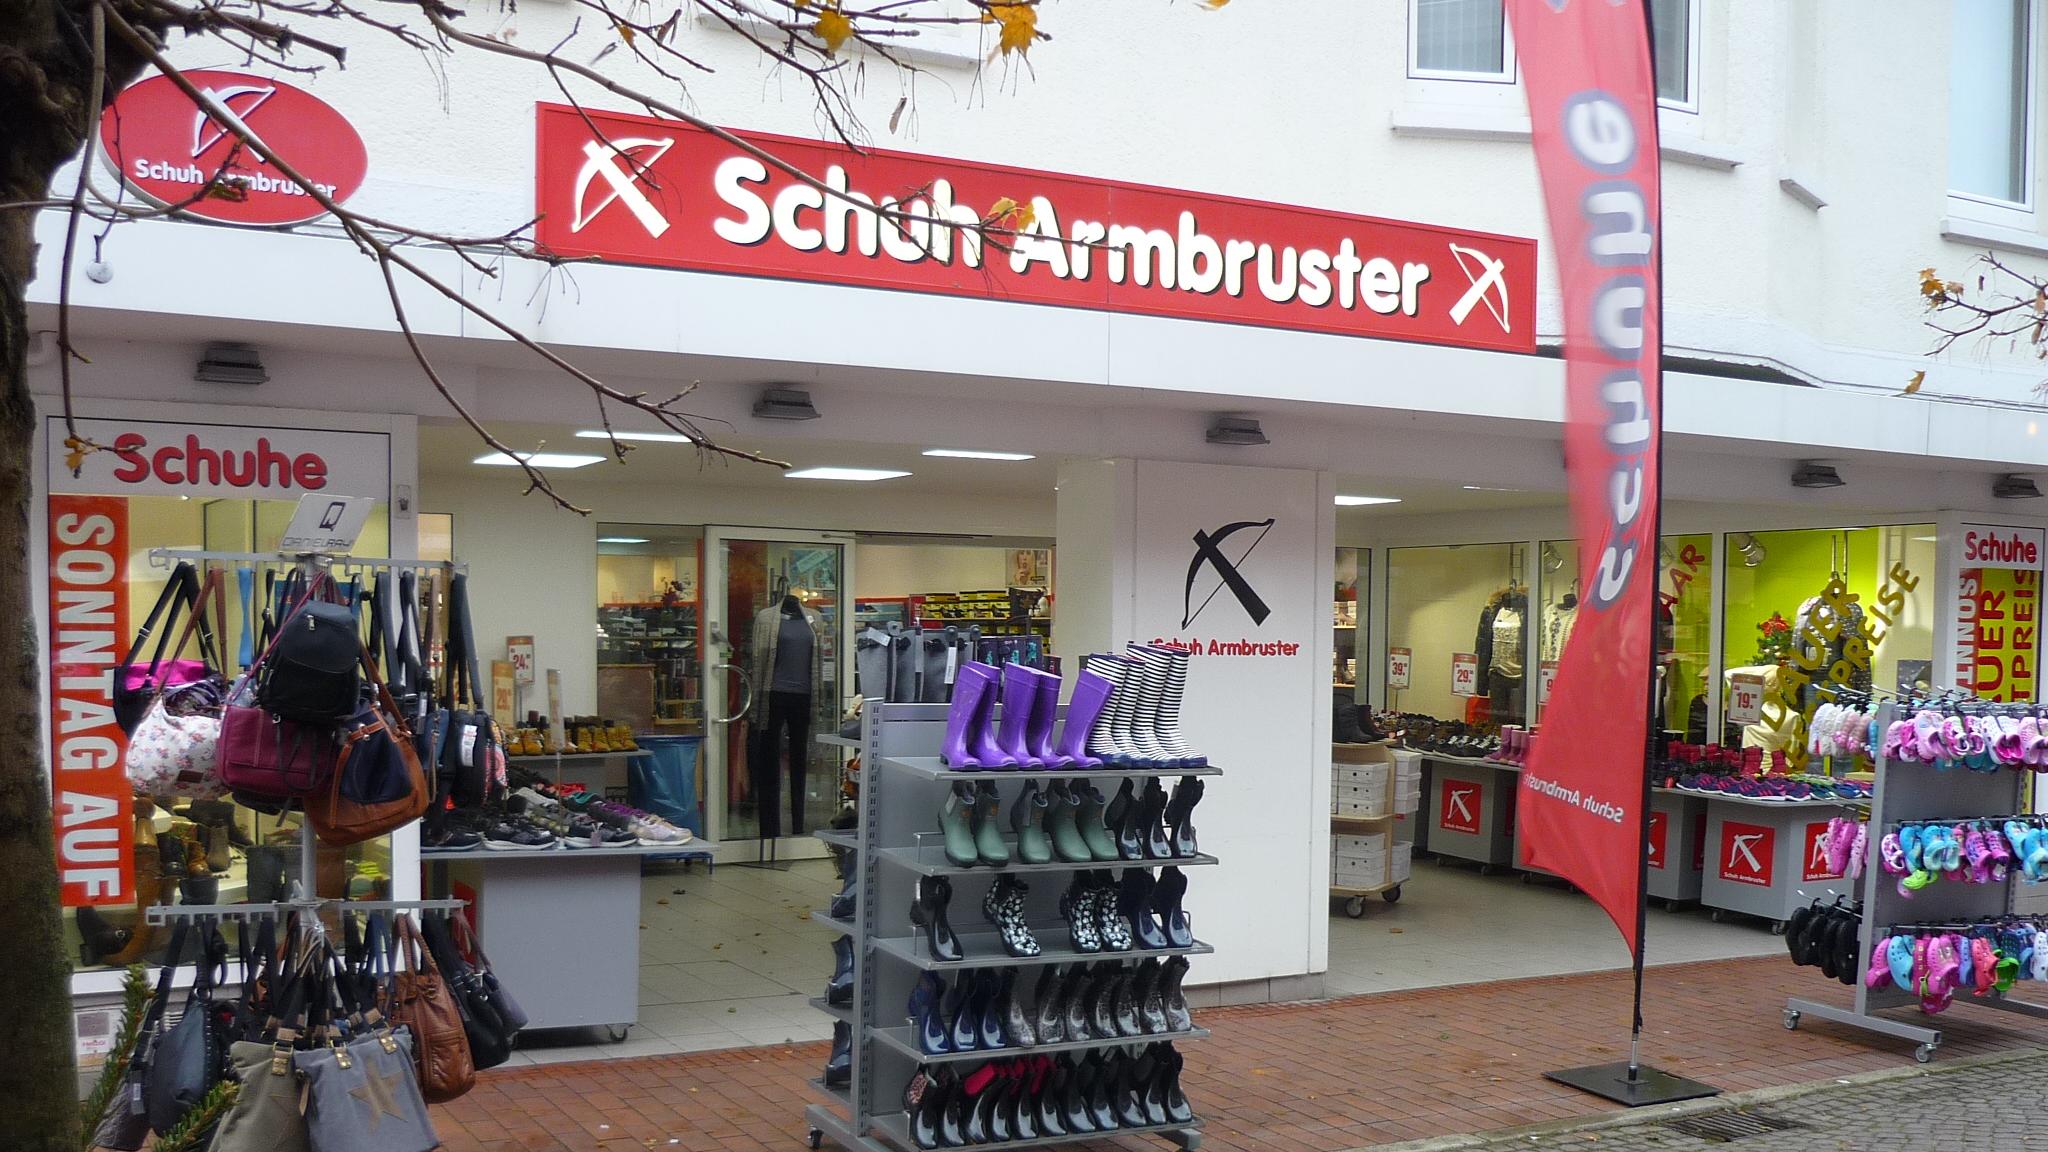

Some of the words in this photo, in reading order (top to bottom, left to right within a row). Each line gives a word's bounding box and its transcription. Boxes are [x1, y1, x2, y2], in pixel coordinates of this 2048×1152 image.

[135, 158, 204, 184] Schuh
[714, 156, 982, 270] Schuh
[1009, 195, 1431, 316] Armbruster
[114, 432, 328, 490] Schuhe
[1964, 531, 2038, 564] Schuhe
[55, 512, 119, 771] SONNTAG
[1207, 638, 1300, 656] Armbruster
[1761, 578, 1860, 732] DAUER
[1977, 590, 2006, 703] UER
[60, 790, 121, 898] AUF
